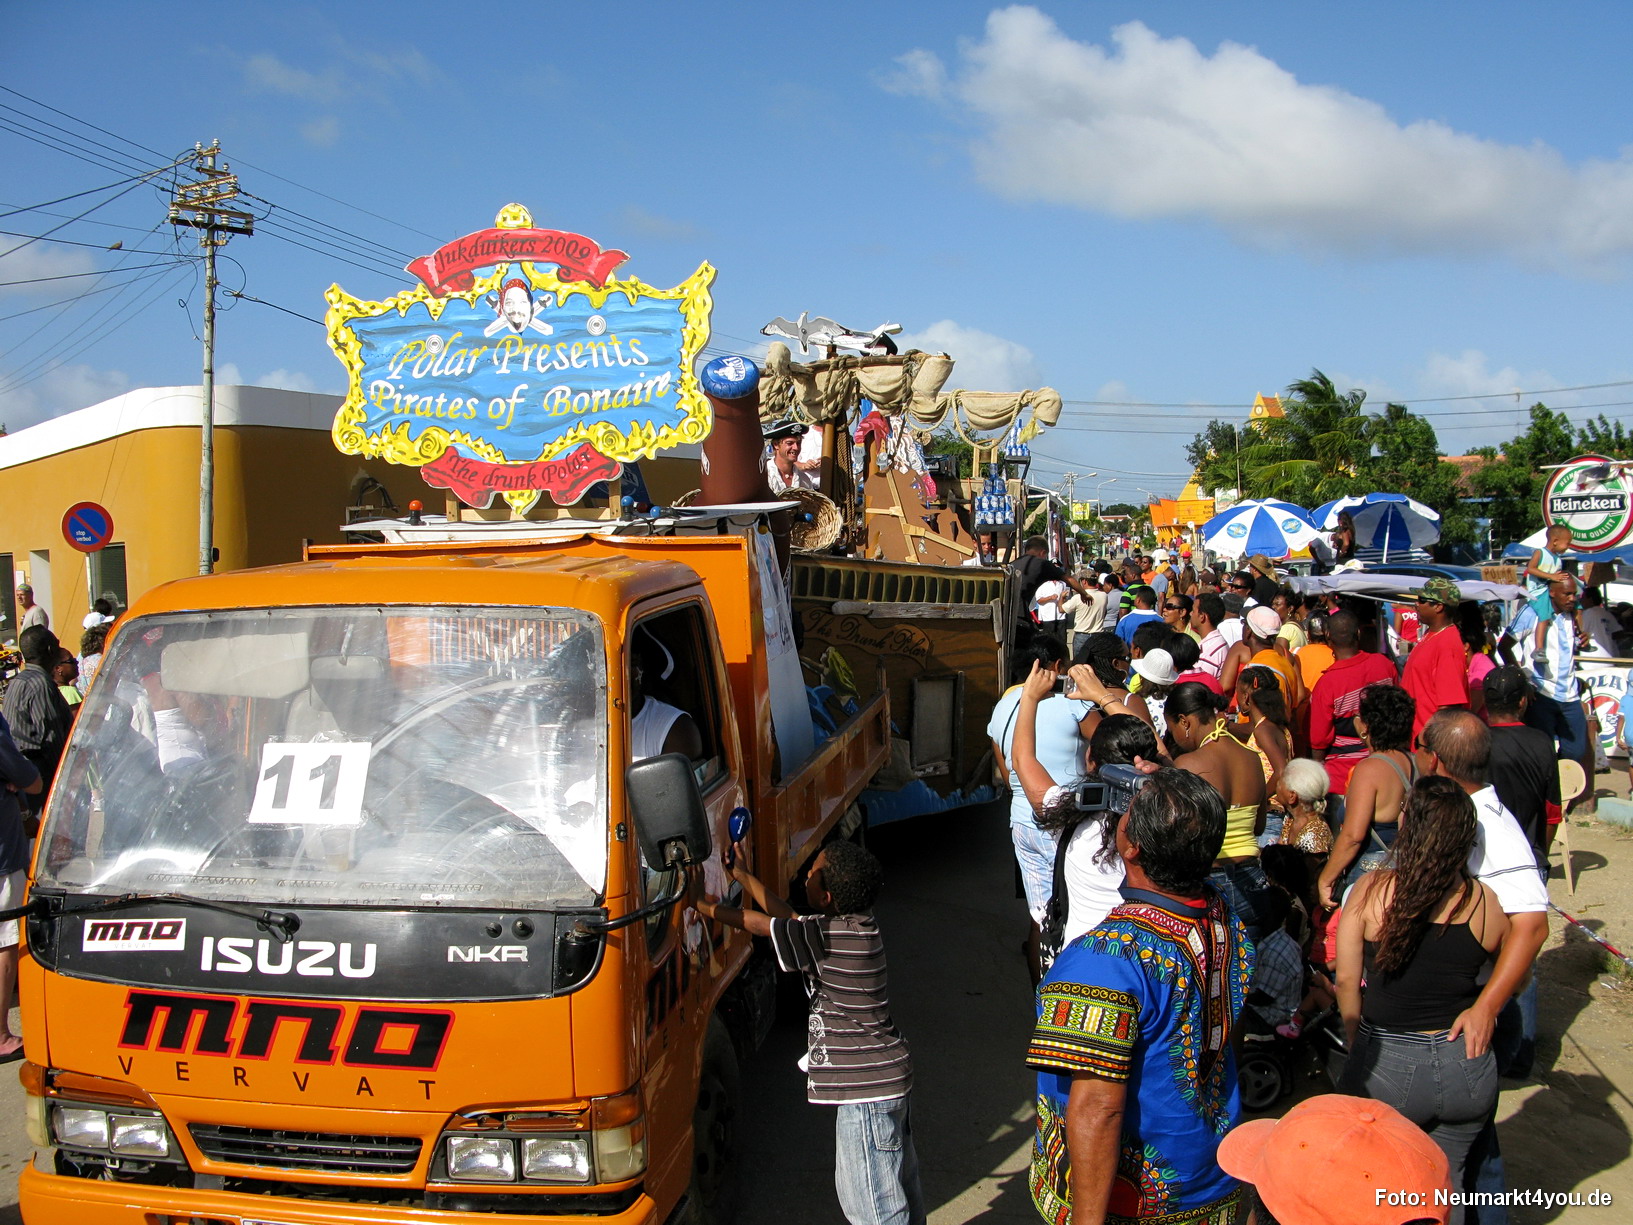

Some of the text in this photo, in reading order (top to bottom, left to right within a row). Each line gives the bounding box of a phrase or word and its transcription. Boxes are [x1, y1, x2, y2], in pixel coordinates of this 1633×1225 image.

[541, 235, 591, 266] 2009
[386, 332, 649, 380] Polar Presents
[370, 371, 671, 430] Pirates of Bonaire
[446, 455, 478, 482] The
[482, 464, 541, 490] drunk
[541, 447, 594, 484] Polar
[1552, 496, 1621, 512] Heineken
[1590, 518, 1616, 538] QUALITY
[837, 616, 894, 649] Drunk
[1586, 674, 1623, 691] OLA
[263, 754, 342, 810] 11
[201, 935, 377, 978] ISUZU
[447, 944, 529, 963] NKR
[118, 1055, 436, 1100] VERVAT
